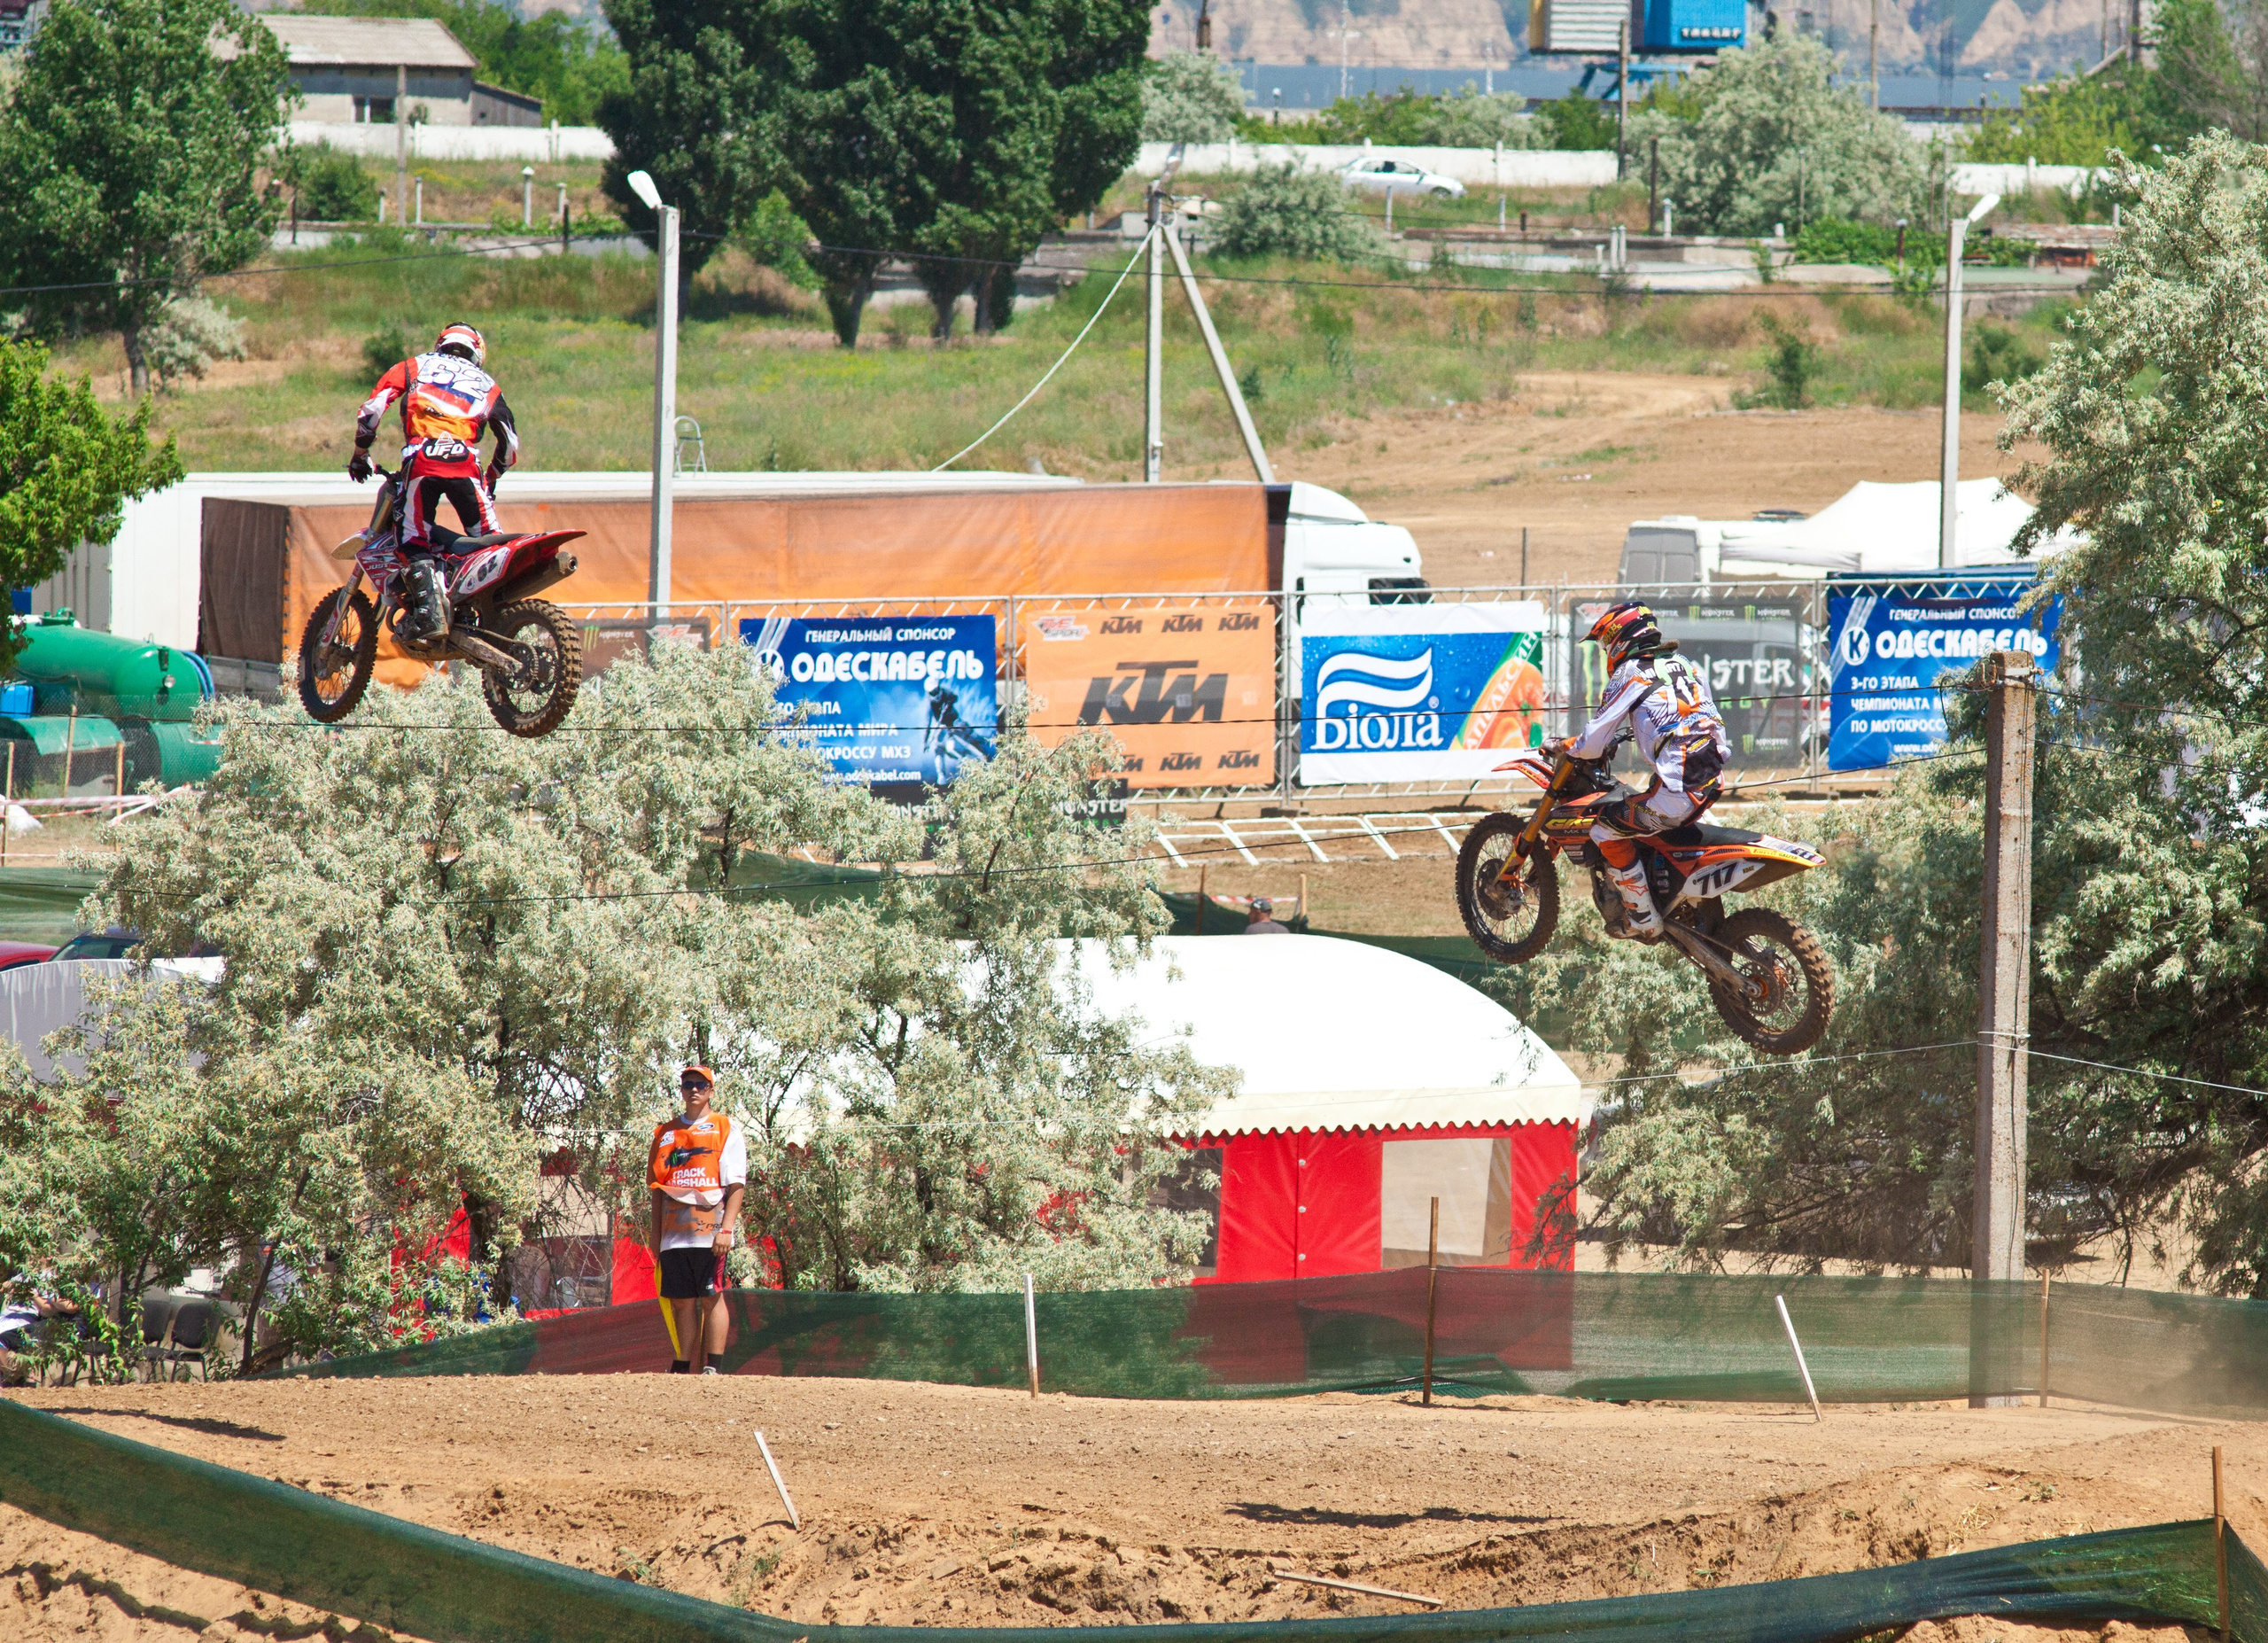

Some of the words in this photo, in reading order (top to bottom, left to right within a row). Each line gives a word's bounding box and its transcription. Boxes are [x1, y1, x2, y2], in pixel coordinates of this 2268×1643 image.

[425, 443, 465, 457] UFO
[1099, 616, 1143, 634] KTM
[1161, 615, 1202, 633] KTM
[1218, 612, 1260, 631] KTM
[1889, 608, 1966, 620] ГЕНЕРАЛЬНЫЙ
[1969, 606, 2023, 619] СПОНСО
[805, 627, 893, 643] ГЕНЕРАЛЬНЫЙ
[896, 627, 956, 642] СПОНСОР
[1876, 628, 2048, 658] ОДЕСКАБЕЛЬ
[791, 650, 984, 683] ОДЕСКАБЕЛЬ
[1691, 653, 1796, 692] NSTER
[1076, 659, 1229, 725] KTM
[1465, 630, 1539, 750] АПЕЛЬСИН
[1881, 676, 1919, 689] ЭТАПА
[1851, 697, 1930, 711] ЧЕМПИОНАТА
[858, 722, 898, 737] МИРА
[1310, 703, 1444, 750] Біола
[1851, 720, 1868, 733] ПО
[1871, 719, 1947, 733] МОТОКРОСС
[1159, 752, 1202, 771] KTM
[1217, 750, 1260, 769] KTM
[1697, 862, 1737, 896] 717
[672, 1167, 706, 1179] TRACK
